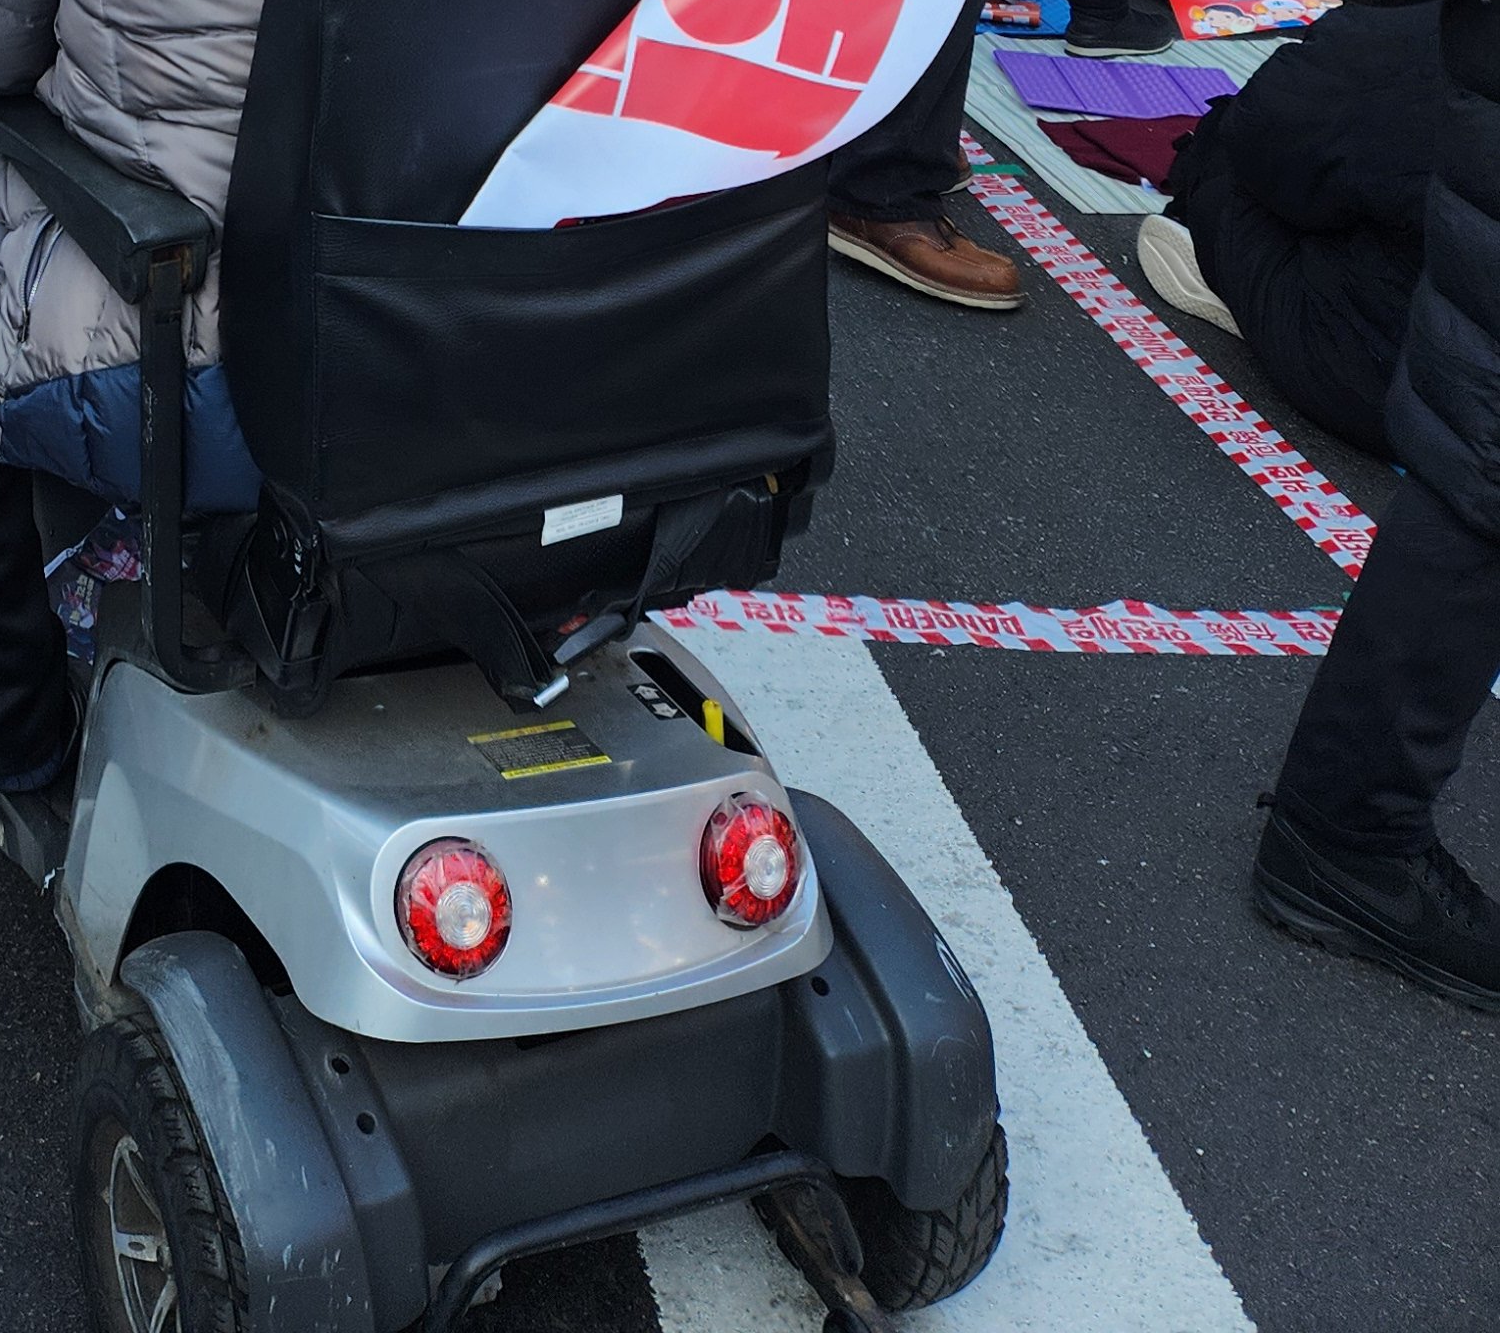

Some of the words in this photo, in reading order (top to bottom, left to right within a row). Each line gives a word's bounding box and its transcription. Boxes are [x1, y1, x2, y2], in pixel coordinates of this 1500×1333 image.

[1113, 313, 1183, 364] DANGER!
[1172, 371, 1243, 425] 안전제일
[1227, 428, 1278, 459] 危險
[1267, 464, 1315, 494] 위험
[741, 599, 806, 624] 위험
[882, 602, 1026, 639] DANGER!
[1062, 612, 1193, 645] 안전제일
[1203, 615, 1278, 644] 危險
